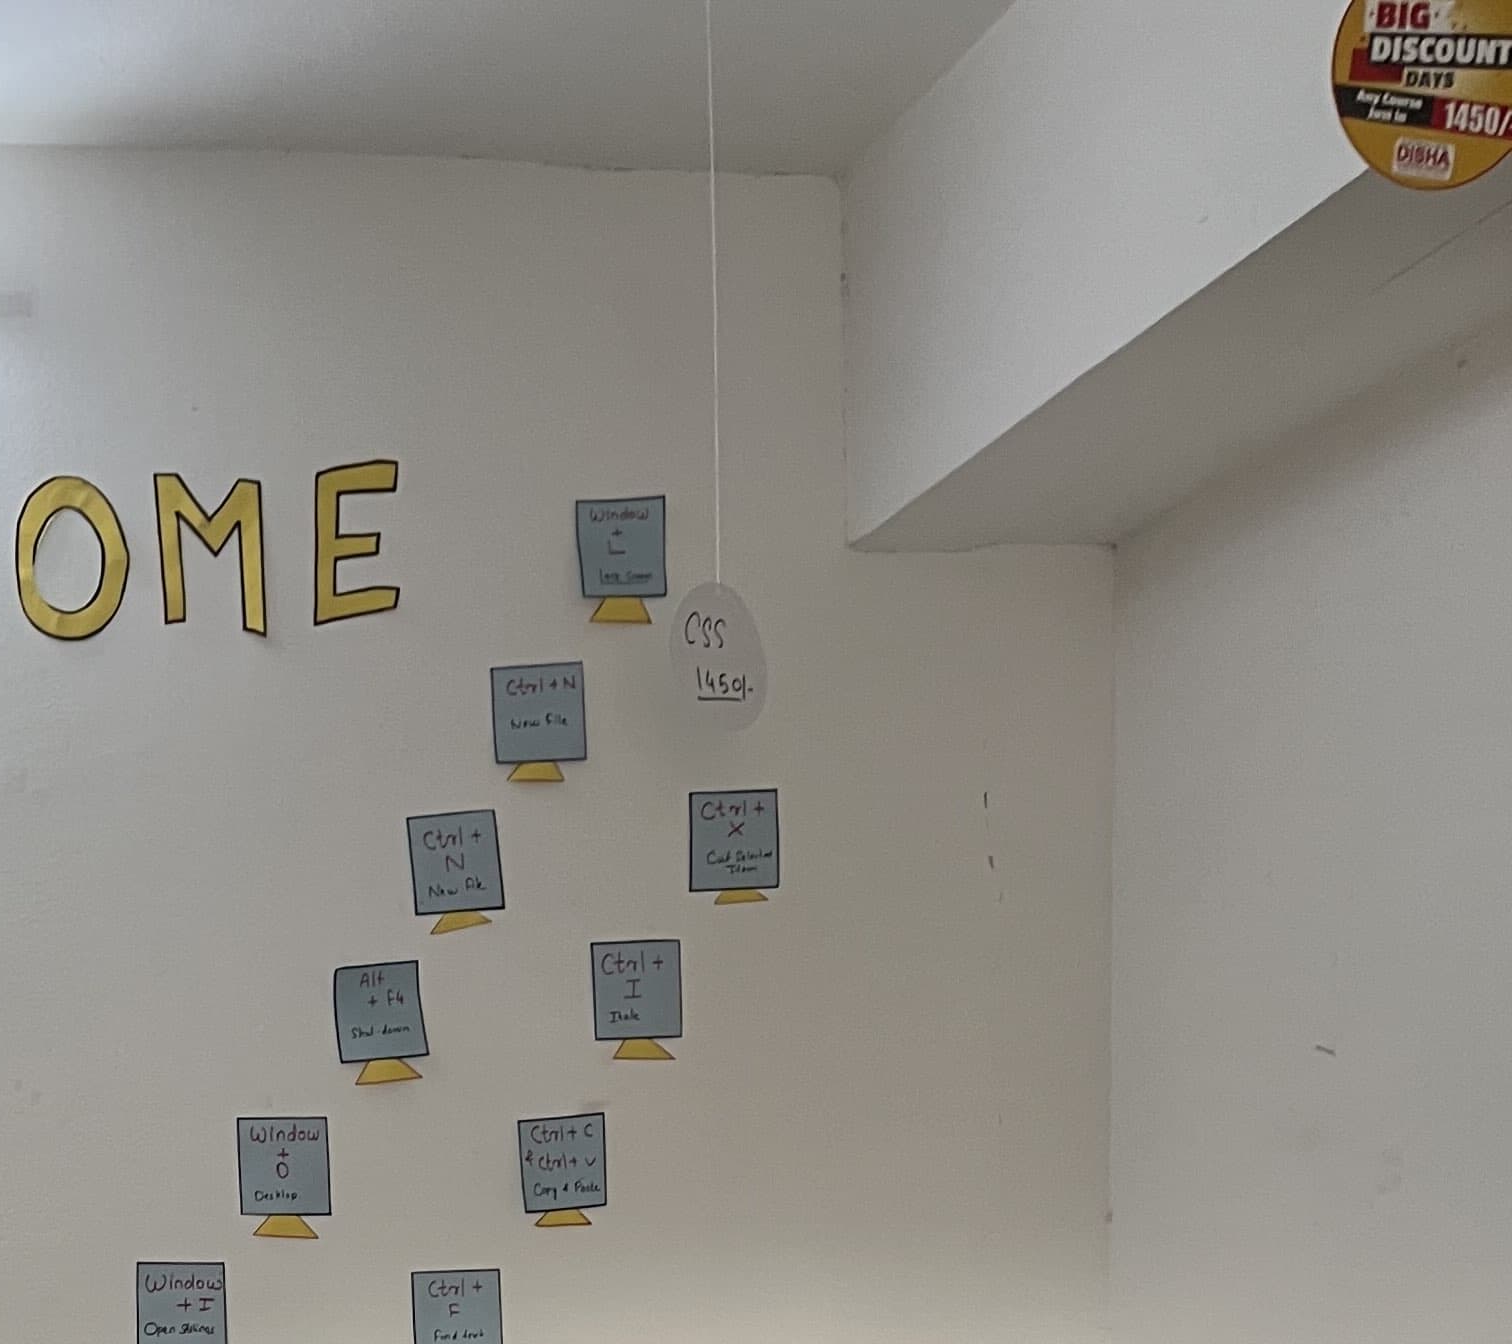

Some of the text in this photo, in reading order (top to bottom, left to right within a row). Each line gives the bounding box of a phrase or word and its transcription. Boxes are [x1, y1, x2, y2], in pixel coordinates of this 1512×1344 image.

[1376, 1, 1431, 30] BIG
[1370, 35, 1512, 65] DISCOUNT
[1405, 71, 1456, 89] DAYS
[608, 539, 626, 555] L
[506, 678, 543, 697] Ctrl
[563, 675, 576, 690] N
[700, 800, 765, 821] Ctrl +
[423, 826, 481, 850] Ctrl +
[727, 821, 745, 838] X
[446, 854, 465, 873] N
[601, 951, 663, 975] Ctrl +
[359, 973, 385, 989] Alt
[368, 989, 404, 1008] + F4
[249, 1124, 320, 1143] Window
[530, 1125, 564, 1144] Ctrl
[567, 1126, 577, 1138] +
[277, 1148, 289, 1160] +
[538, 1153, 567, 1171] Ctrl
[568, 1157, 577, 1167] +
[144, 1272, 223, 1294] Window
[428, 1279, 483, 1298] Ctrl +
[176, 1297, 192, 1313] +
[448, 1303, 460, 1318] F
[143, 1322, 176, 1338] Open
